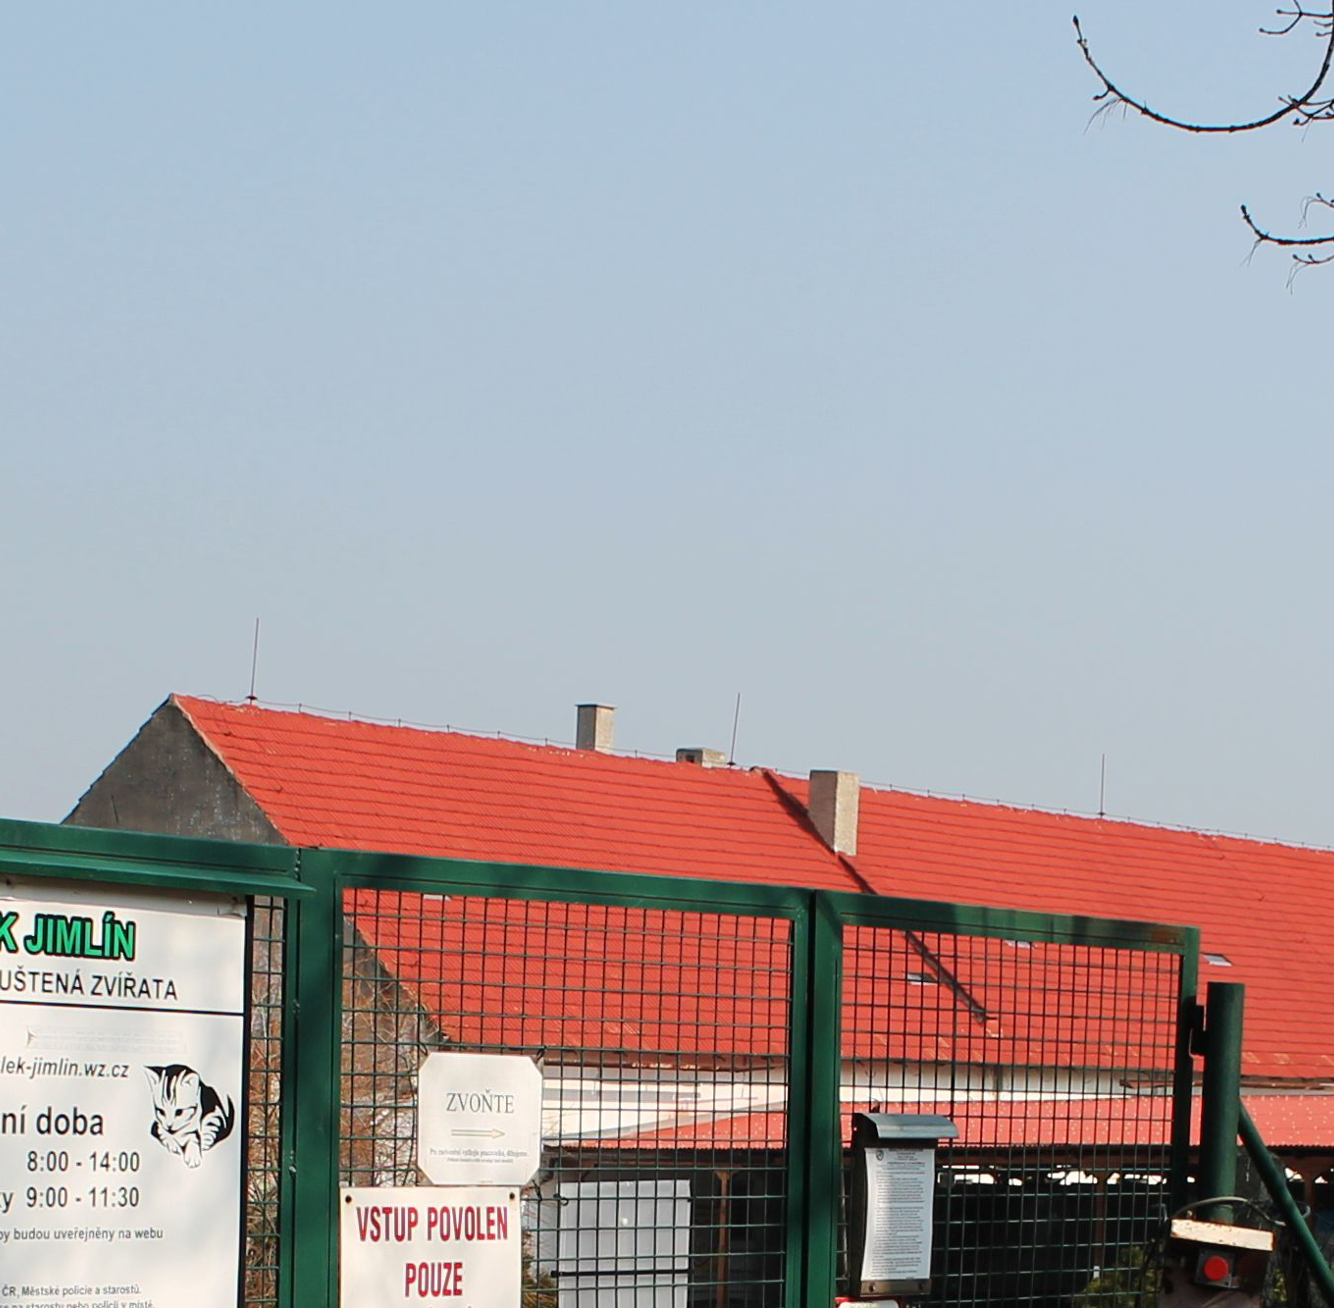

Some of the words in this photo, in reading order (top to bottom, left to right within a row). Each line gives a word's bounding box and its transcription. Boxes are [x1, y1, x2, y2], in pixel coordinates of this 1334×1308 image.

[24, 912, 136, 961] JIMLÍN
[90, 969, 177, 1001] ZVÍŘATA
[446, 1088, 515, 1114] ZVOŇTE
[36, 1106, 103, 1135] doba
[27, 1150, 69, 1173] 8:00
[89, 1152, 140, 1173] 14:00
[26, 1187, 67, 1208] 9:00
[88, 1187, 139, 1208] 11:30
[13, 1226, 50, 1241] budou
[53, 1225, 115, 1242] uveřejněny
[118, 1230, 132, 1240] na
[135, 1227, 163, 1239] webu
[356, 1206, 418, 1242] VSTUP
[427, 1206, 508, 1241] POVOLEN
[62, 1285, 92, 1298] policie
[405, 1262, 463, 1297] POUZE
